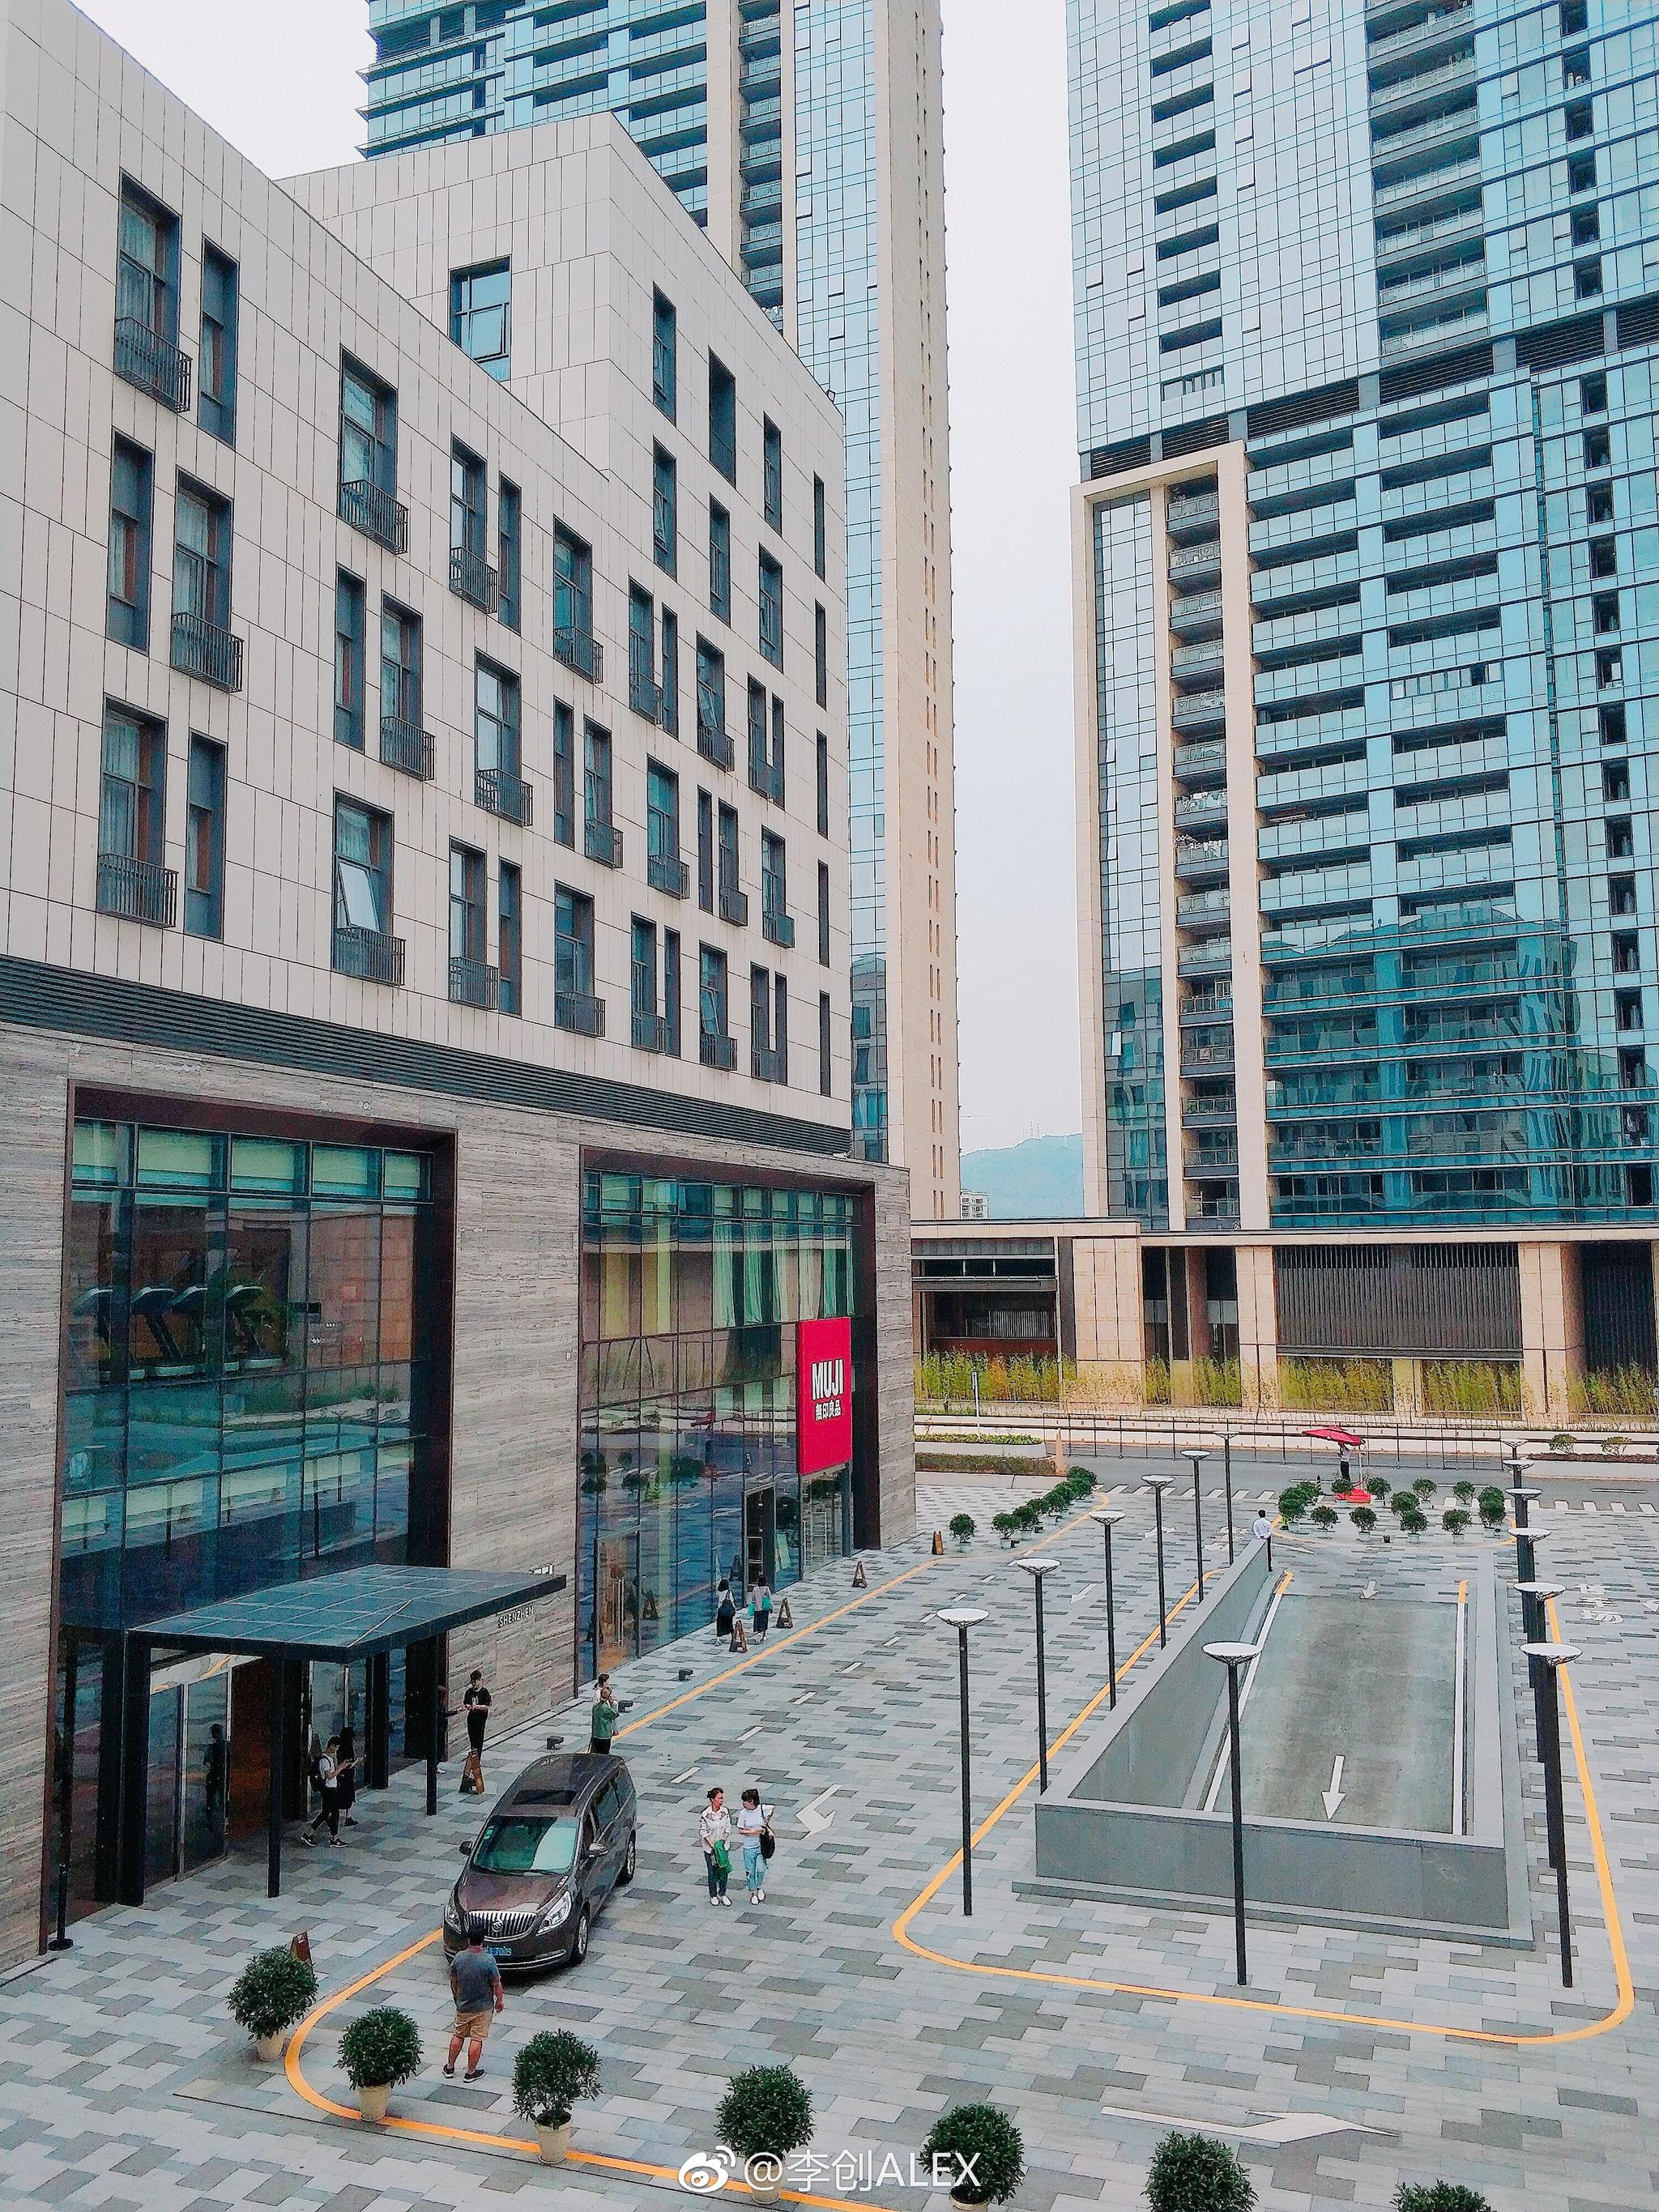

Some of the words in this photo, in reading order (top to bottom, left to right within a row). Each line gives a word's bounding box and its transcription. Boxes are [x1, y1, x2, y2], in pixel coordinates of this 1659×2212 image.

[812, 1359, 843, 1400] MUJI
[815, 1400, 842, 1421] 無印良品
[498, 1605, 535, 1627] SHENZHEN
